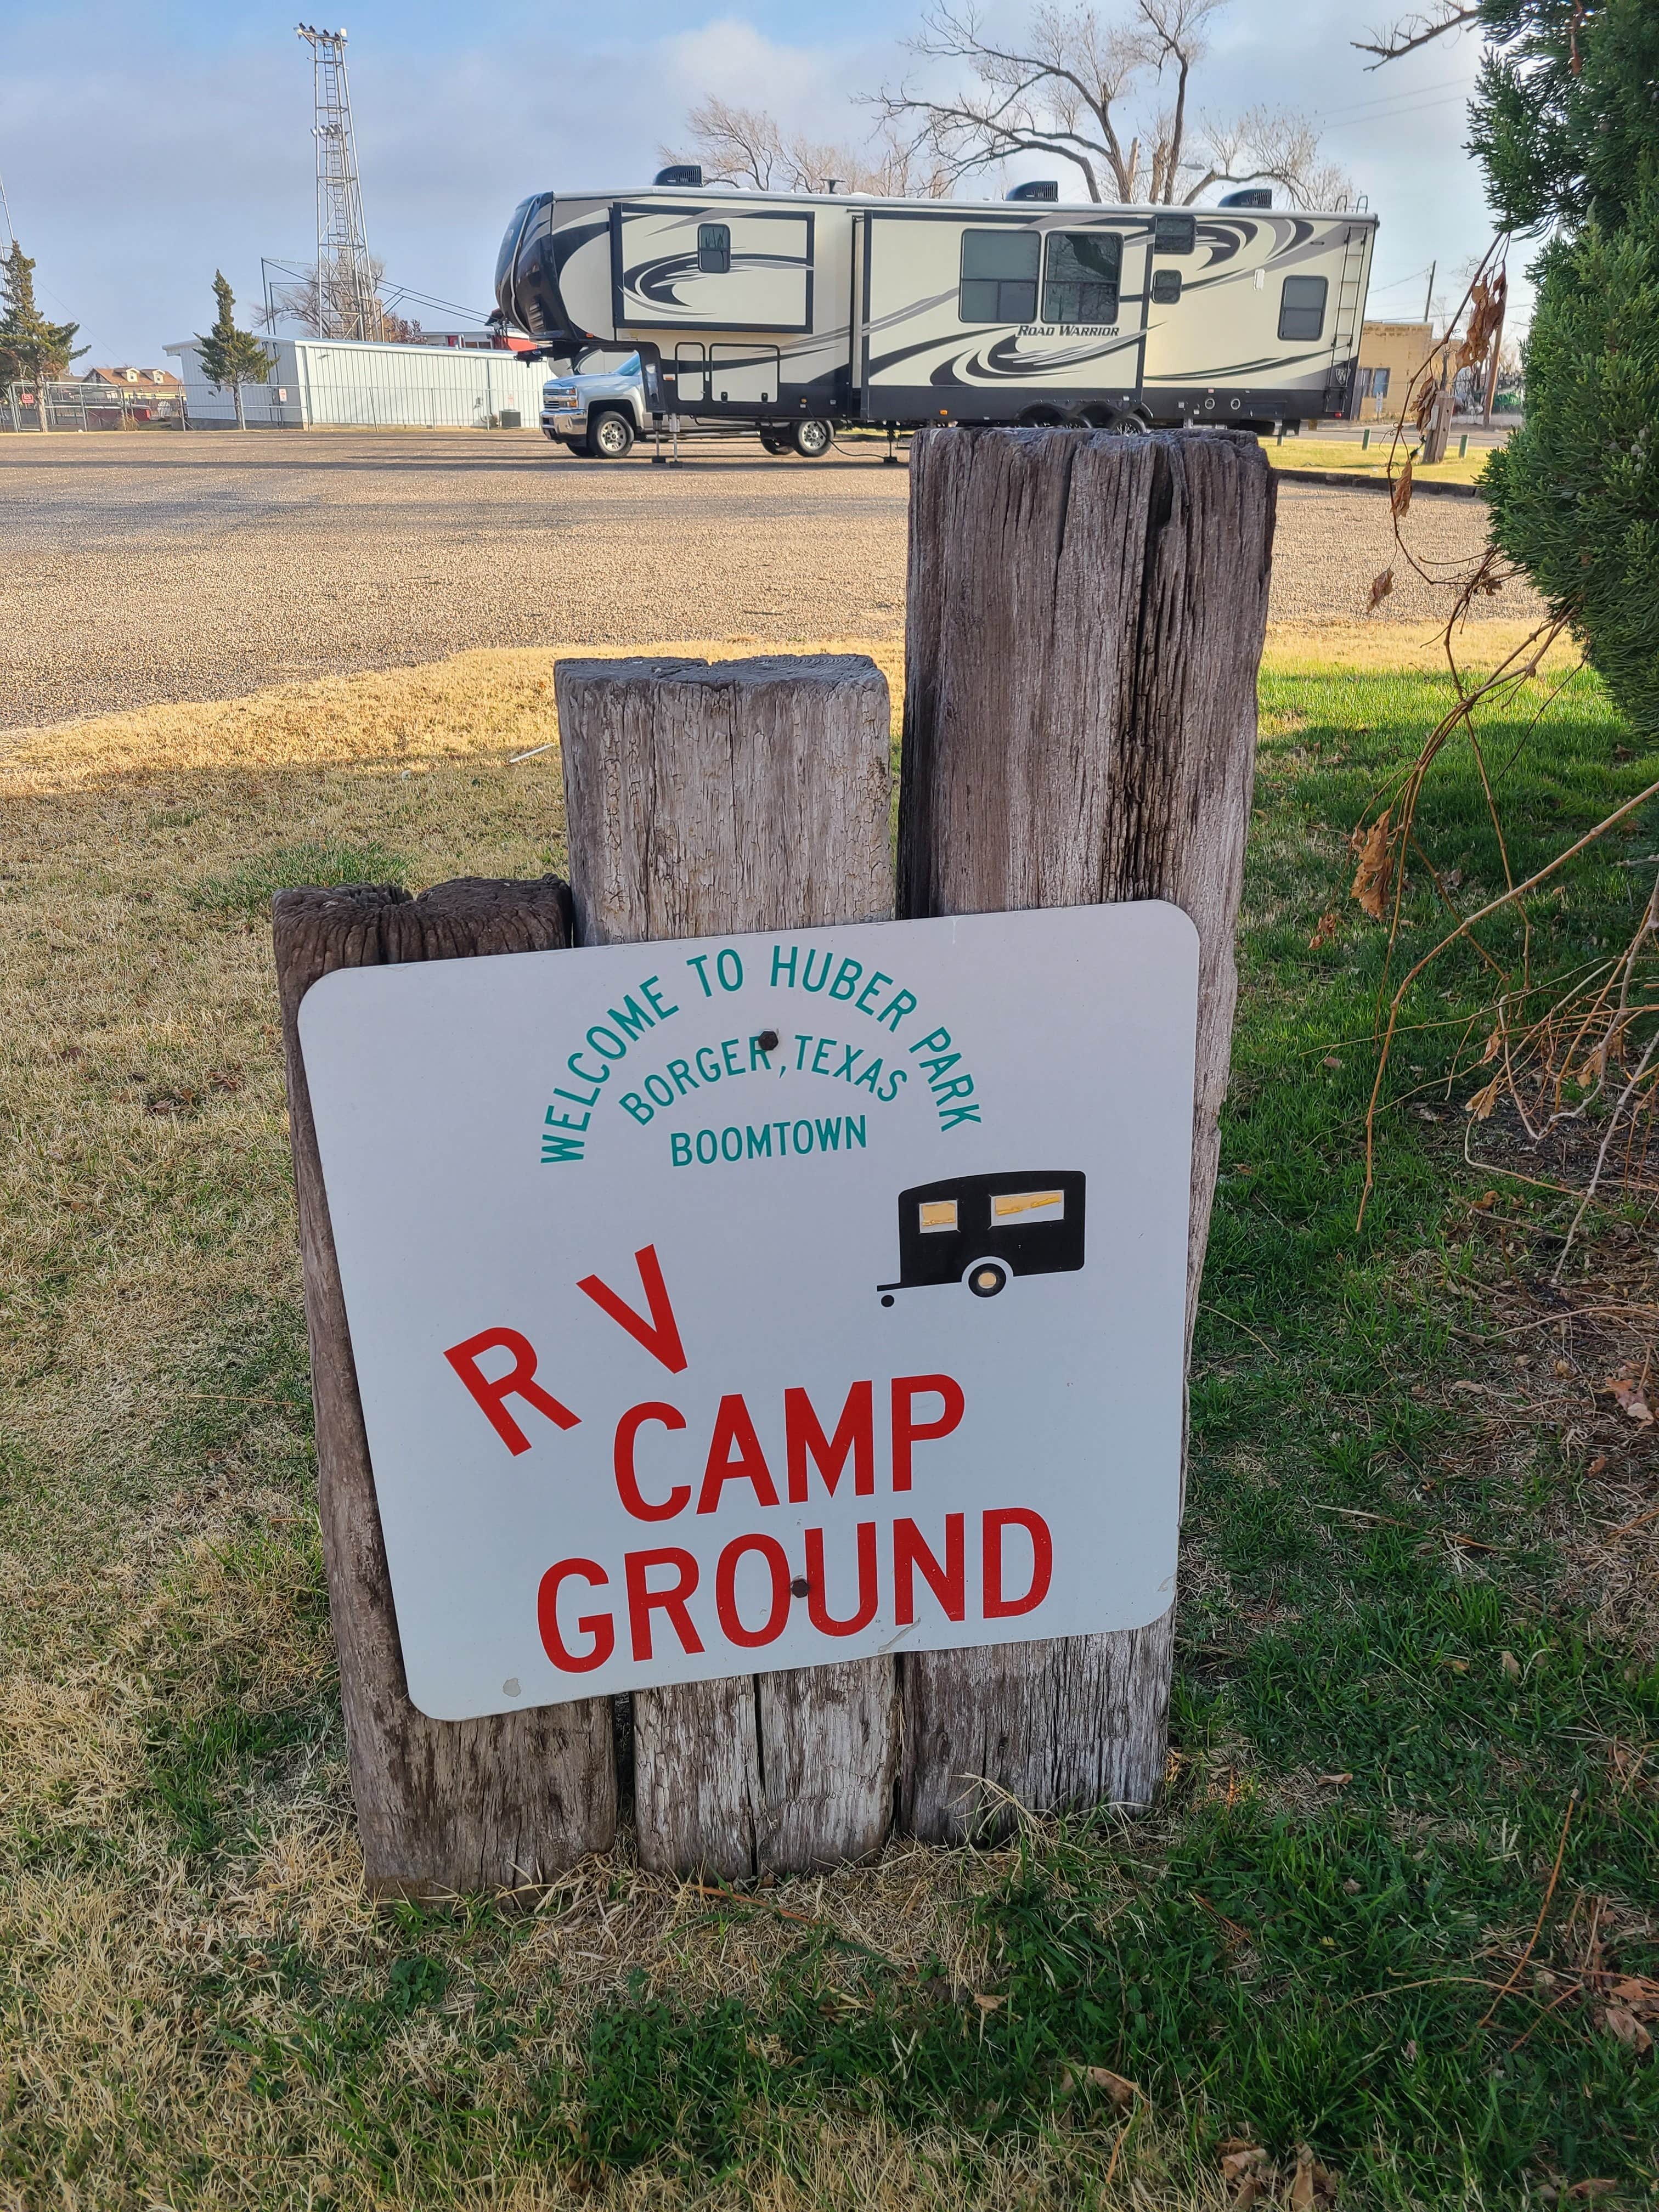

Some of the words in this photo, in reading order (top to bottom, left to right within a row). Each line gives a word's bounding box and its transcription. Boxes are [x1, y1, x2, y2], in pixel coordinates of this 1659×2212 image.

[1018, 325, 1054, 336] ROAD
[1059, 325, 1120, 336] WARRIOR
[540, 975, 680, 1164] WELCOME
[685, 949, 743, 997] TO
[770, 945, 917, 1032] HUBER
[909, 1026, 981, 1131] PARK
[794, 1035, 907, 1102] TEXAS
[670, 1114, 866, 1167] BOOMTOWN
[614, 1374, 964, 1522] CAMP
[537, 1508, 1052, 1673] GROUND
